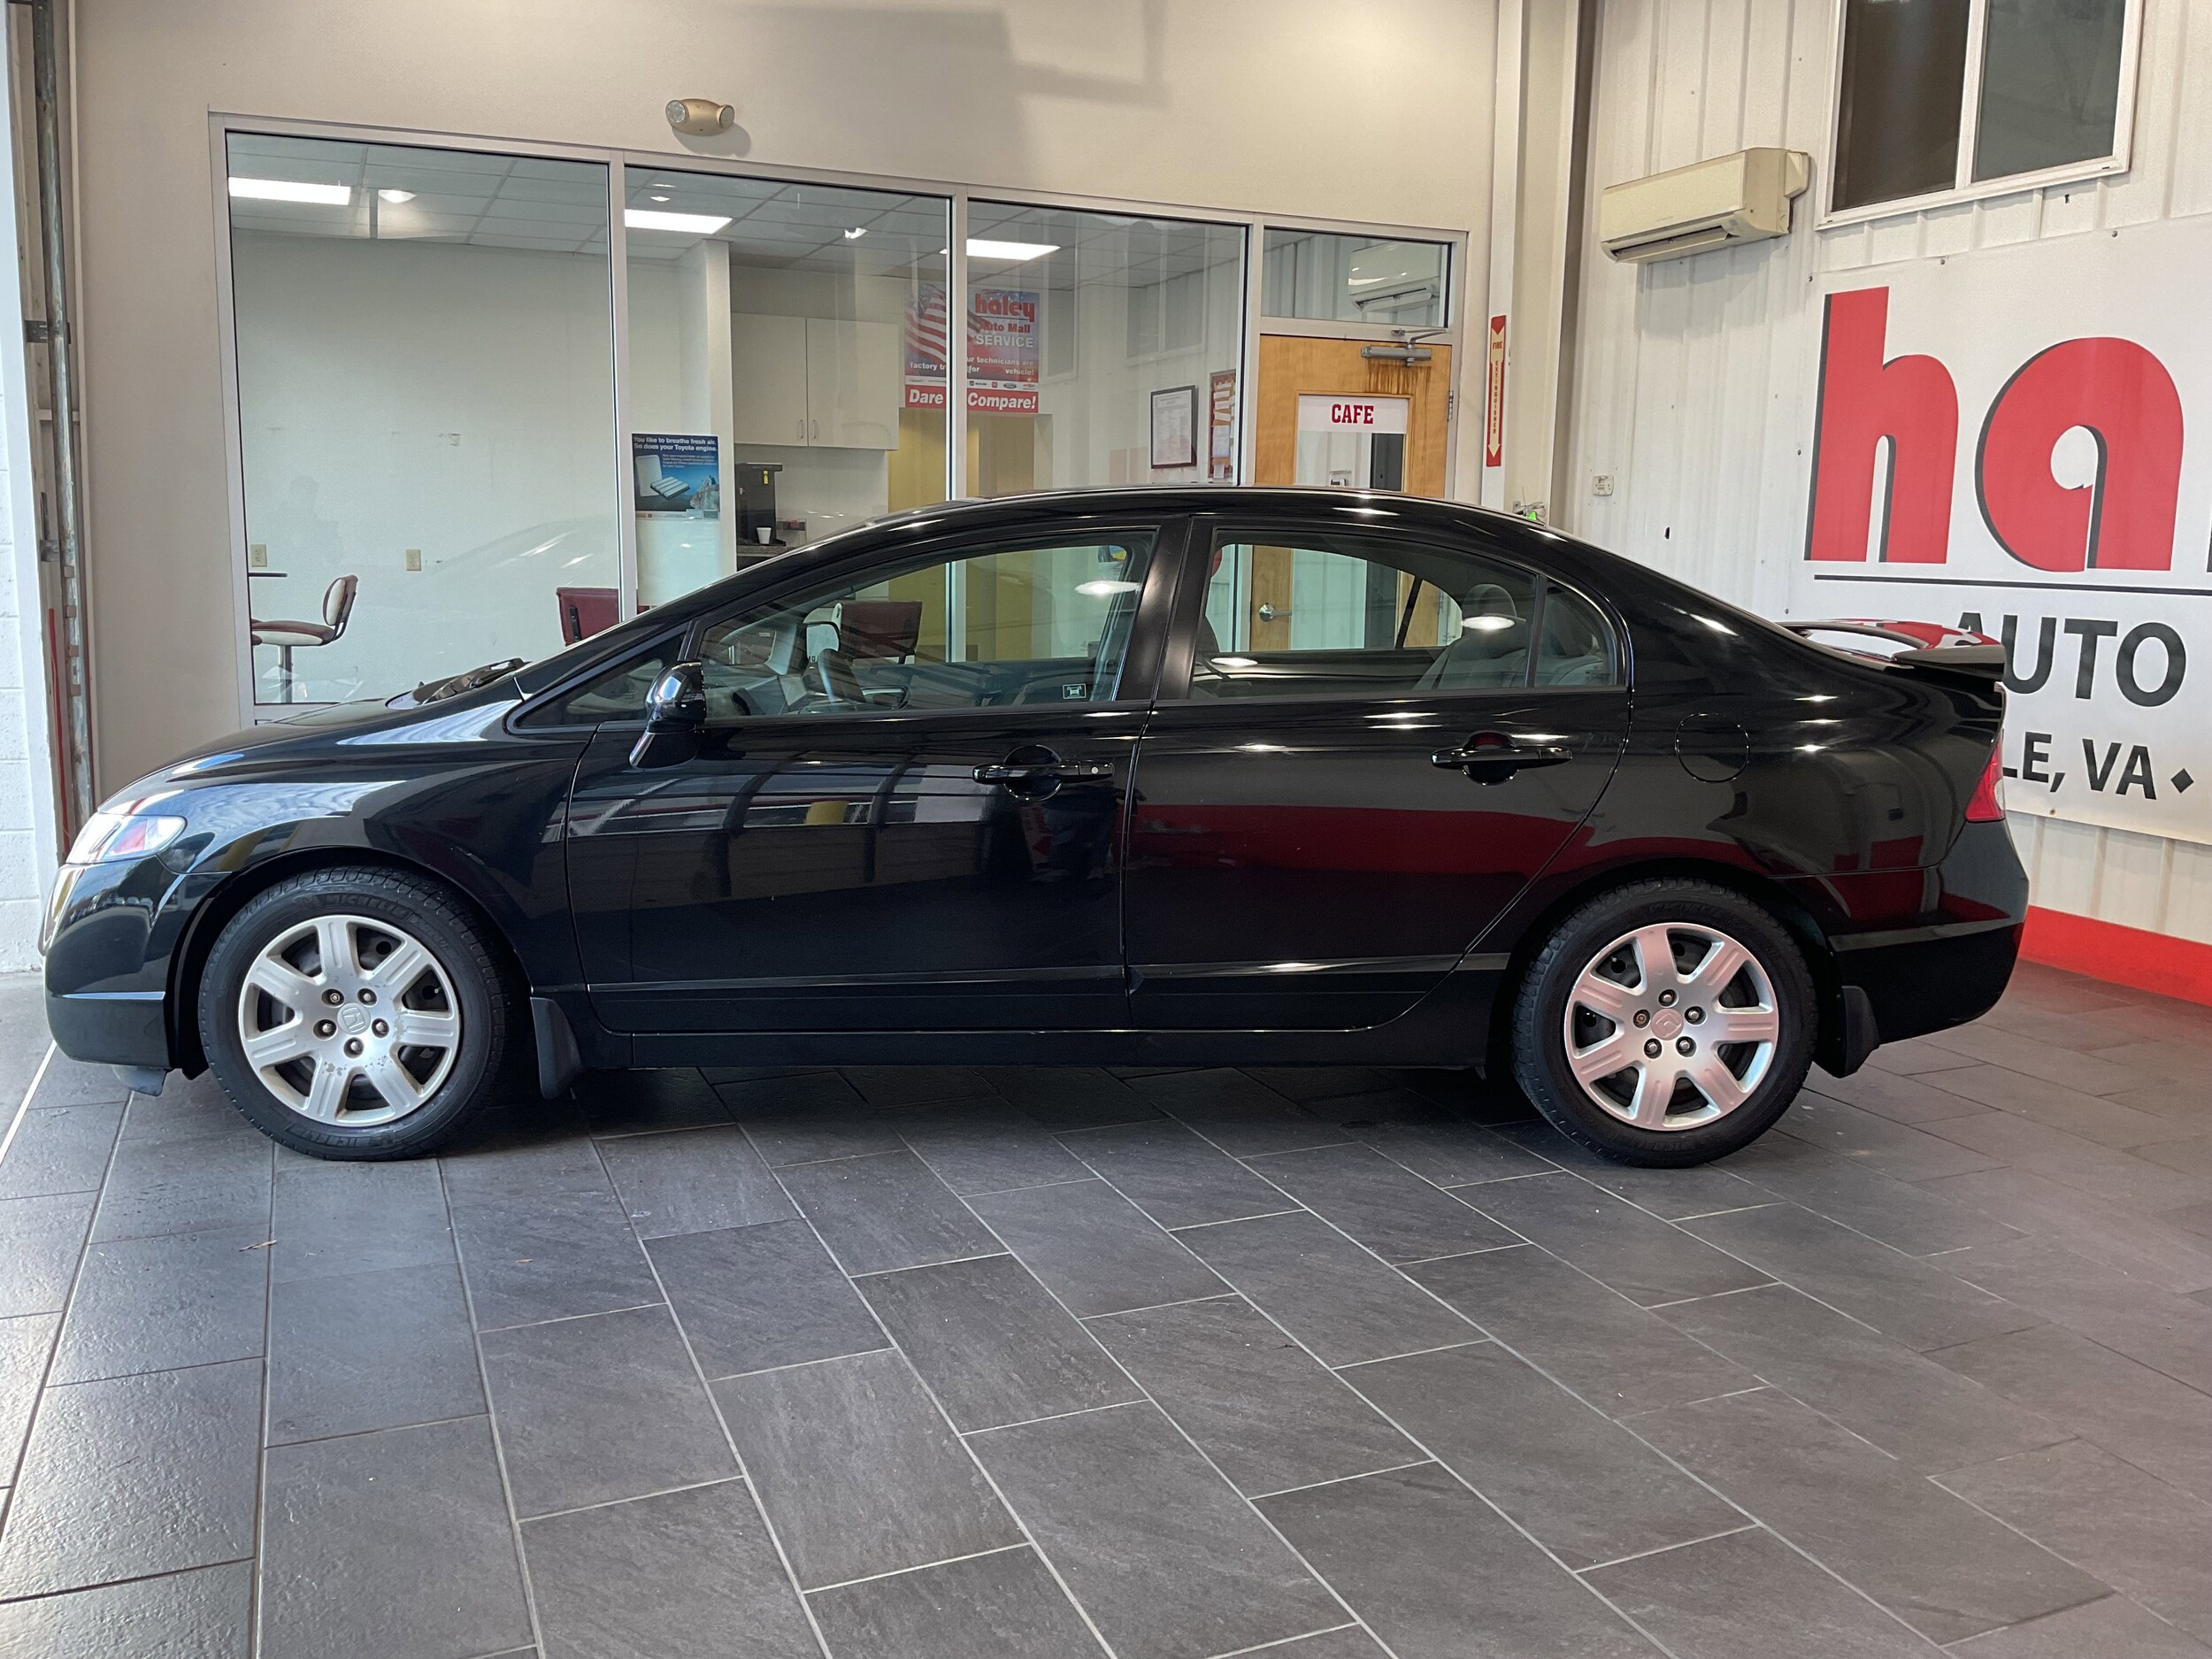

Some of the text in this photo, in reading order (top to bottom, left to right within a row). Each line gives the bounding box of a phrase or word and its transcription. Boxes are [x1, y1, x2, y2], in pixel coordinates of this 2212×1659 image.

[975, 293, 1035, 323] haley
[1008, 323, 1032, 334] Mall
[976, 334, 1034, 349] SERVICE
[910, 362, 938, 372] factory
[969, 365, 980, 373] for
[977, 356, 1020, 366] technicians
[909, 388, 1036, 411] Dare Compare!
[1332, 403, 1374, 425] CAFE
[1803, 286, 2212, 572] ha
[1957, 611, 2186, 708] UTO
[2002, 731, 2157, 801] E, VA
